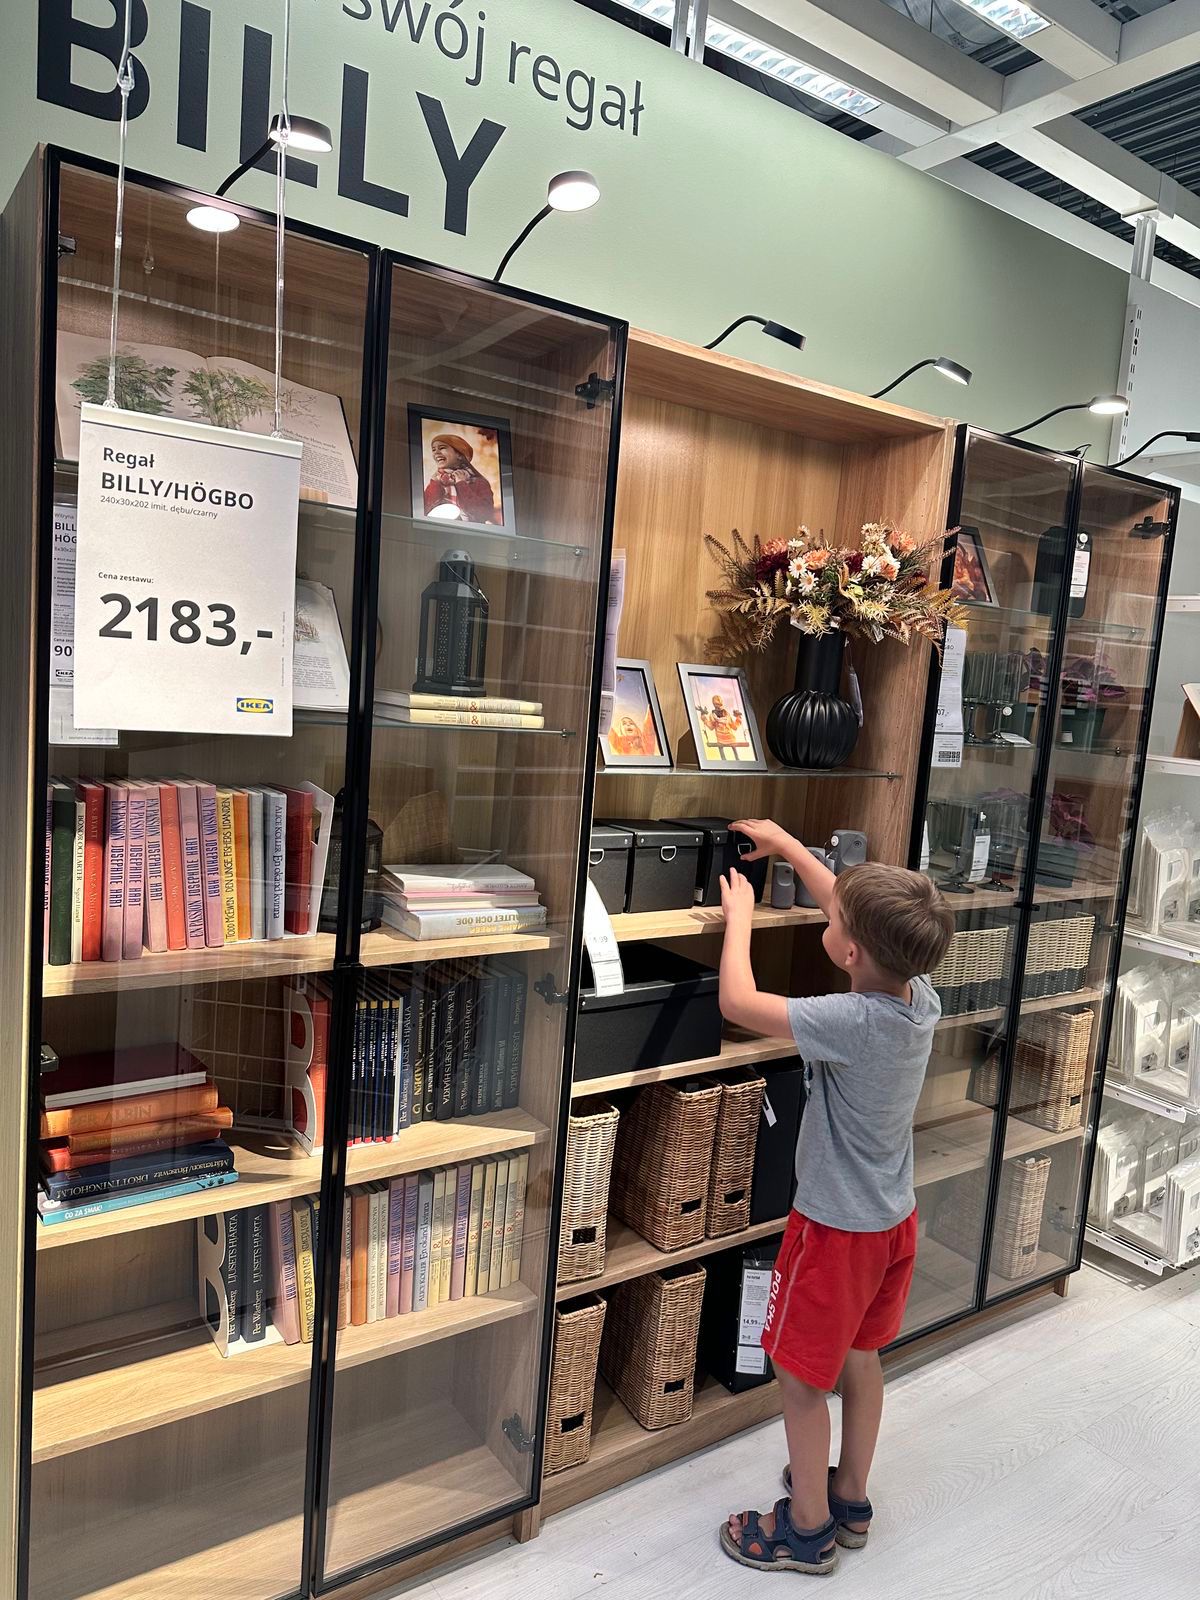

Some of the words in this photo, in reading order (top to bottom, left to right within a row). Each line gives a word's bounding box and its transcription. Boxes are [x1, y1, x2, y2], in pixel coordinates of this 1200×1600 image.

[508, 40, 645, 136] regał
[37, 0, 506, 236] BILLY
[103, 447, 154, 469] Regał
[101, 472, 254, 509] BILLY/HÖGBO
[101, 495, 149, 508] 240x30x202
[151, 503, 168, 512] imit.
[170, 506, 218, 519] dębu/czarny
[98, 572, 118, 580] Cena
[120, 574, 154, 584] zestawu:
[98, 592, 272, 655] 2183,-
[54, 645, 72, 656] 90
[239, 700, 272, 711] IKEA
[111, 800, 126, 811] EN
[130, 800, 145, 810] EN
[275, 805, 283, 826] ALICE
[111, 812, 125, 841] PASSION
[129, 812, 145, 840] PASSION
[146, 810, 160, 837] PASSION
[202, 808, 218, 836] PASSION
[185, 837, 198, 856] HART
[222, 832, 232, 856] FISHERS
[274, 827, 282, 853] KOLLER
[110, 845, 124, 884] JOSEPHINE
[129, 844, 142, 883] JOSEPHINE
[148, 840, 162, 879] JOSEPHINE
[206, 840, 219, 876] JOSEPHINE
[224, 859, 233, 878] UNGE
[273, 855, 282, 867] En
[187, 859, 200, 896] JOSEPHINE
[208, 880, 220, 898] HART
[225, 880, 234, 892] DEN
[109, 889, 122, 908] HART
[128, 888, 141, 906] HART
[150, 882, 163, 902] HART
[188, 900, 203, 927] PASSION
[273, 894, 282, 919] kvinna
[189, 927, 203, 937] EN
[444, 1040, 452, 1072] LJUSETS
[399, 1111, 407, 1122] Per
[56, 1174, 149, 1199] DROTTNINGHOLM
[64, 1211, 74, 1220] CO
[75, 1209, 84, 1218] ZA
[421, 1202, 429, 1225] kvinna
[456, 1209, 467, 1241] JOSEPHINE
[390, 1225, 401, 1256] JOSEPHINE
[404, 1222, 415, 1253] JOSEPHINE
[302, 1256, 310, 1268] DEN
[420, 1249, 428, 1259] En
[455, 1244, 465, 1259] HART
[228, 1249, 238, 1283] LJUSETS
[253, 1250, 263, 1283] LJUSETS
[283, 1248, 294, 1281] JOSEPHINE
[390, 1260, 399, 1275] HART
[404, 1256, 413, 1272] HART
[286, 1283, 296, 1301] HART
[765, 1269, 782, 1332] POLSKA
[253, 1324, 261, 1334] Per
